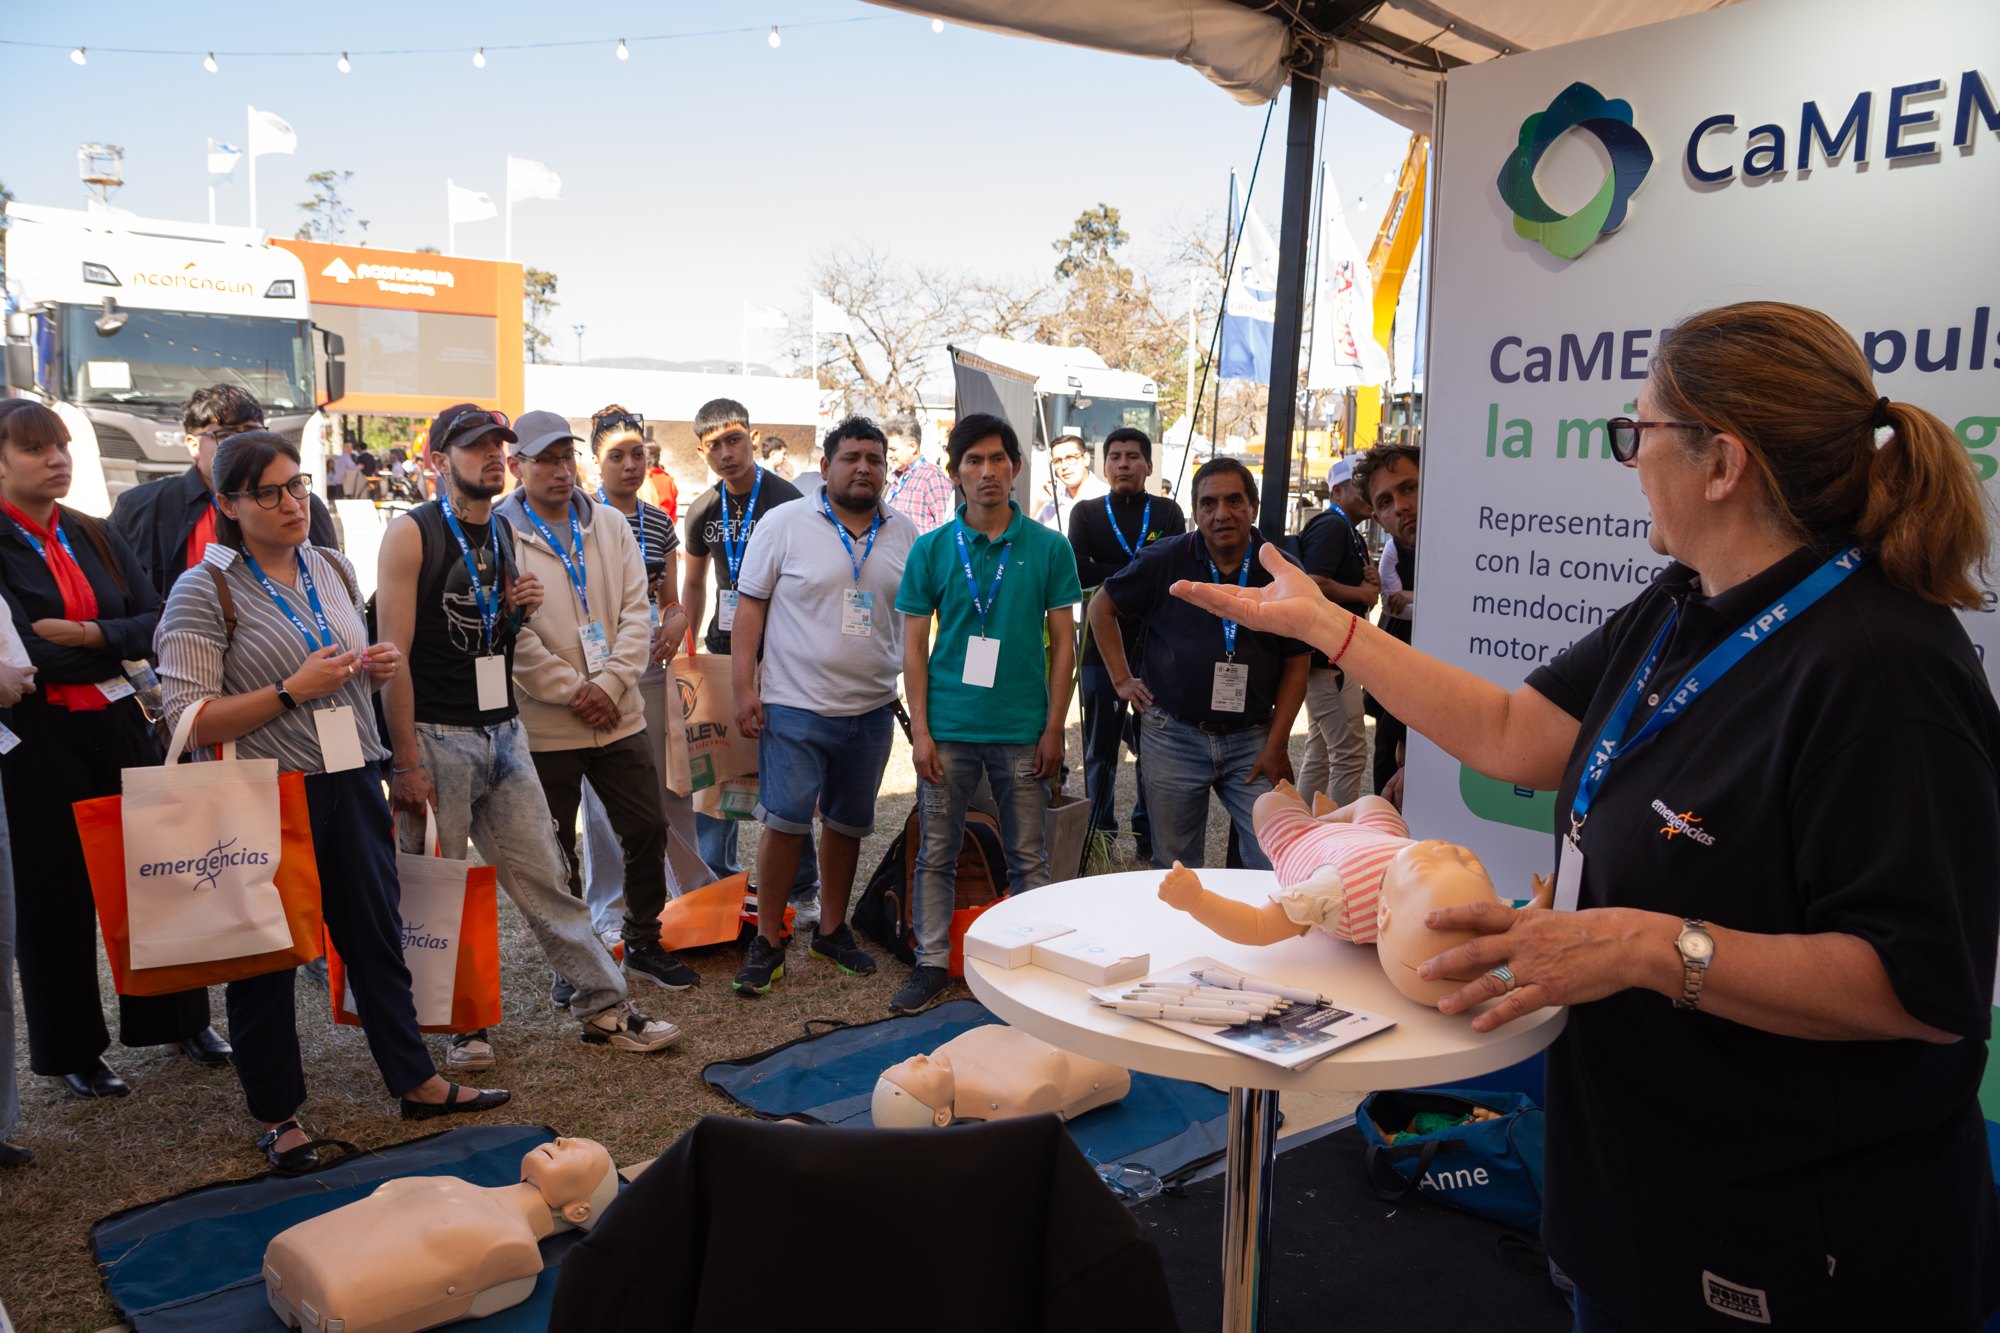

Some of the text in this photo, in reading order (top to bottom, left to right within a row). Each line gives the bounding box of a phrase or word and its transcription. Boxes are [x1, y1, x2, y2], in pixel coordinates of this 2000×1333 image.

[1490, 329, 1676, 383] CaME
[1486, 403, 1533, 459] la
[1479, 506, 1652, 539] Representam
[302, 572, 313, 591] YPF
[995, 563, 1004, 580] YPF
[1475, 550, 1673, 586] con la convicc
[262, 578, 278, 597] YPF
[291, 615, 310, 634] YPF
[314, 611, 327, 631] YPF
[1741, 603, 1789, 642] YPF
[1469, 636, 1549, 663] motor
[1662, 677, 1700, 716] YPF
[1651, 798, 1716, 847] emergencias
[139, 847, 269, 877] emergencias
[401, 933, 449, 950] encias
[1420, 1167, 1489, 1191] Anne
[1708, 1283, 1760, 1310] WORKS
